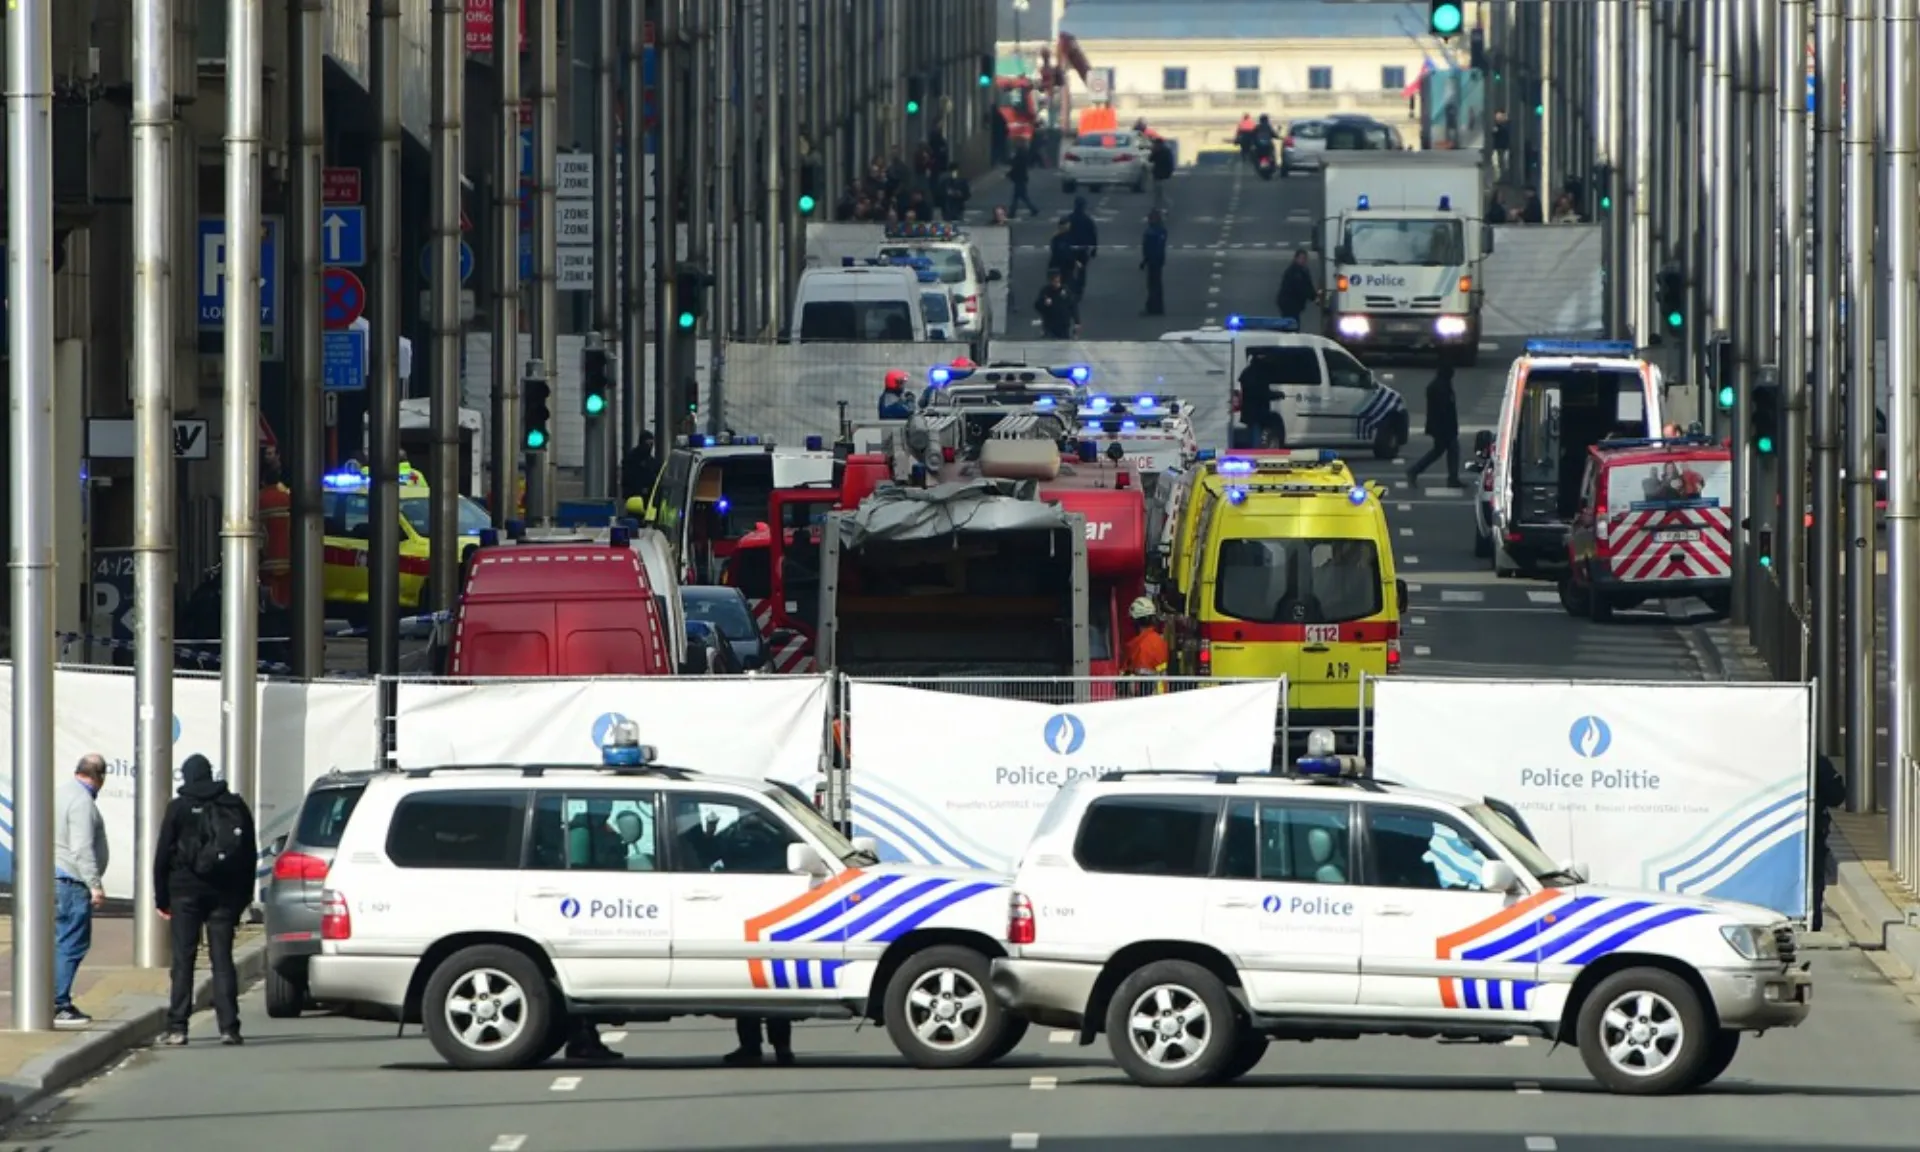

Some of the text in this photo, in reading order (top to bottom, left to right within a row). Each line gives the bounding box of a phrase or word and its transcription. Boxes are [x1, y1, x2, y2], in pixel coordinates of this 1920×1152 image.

[563, 162, 589, 173] ZONE
[563, 178, 589, 189] ZONE
[563, 209, 589, 219] ZONE
[563, 224, 589, 235] ZONE
[1366, 275, 1405, 286] Police
[1315, 626, 1337, 641] 112
[1326, 661, 1336, 679] A
[996, 766, 1057, 785] Police
[1521, 767, 1661, 790] Police Politie
[590, 898, 659, 919] Police
[1290, 896, 1354, 916] Police
